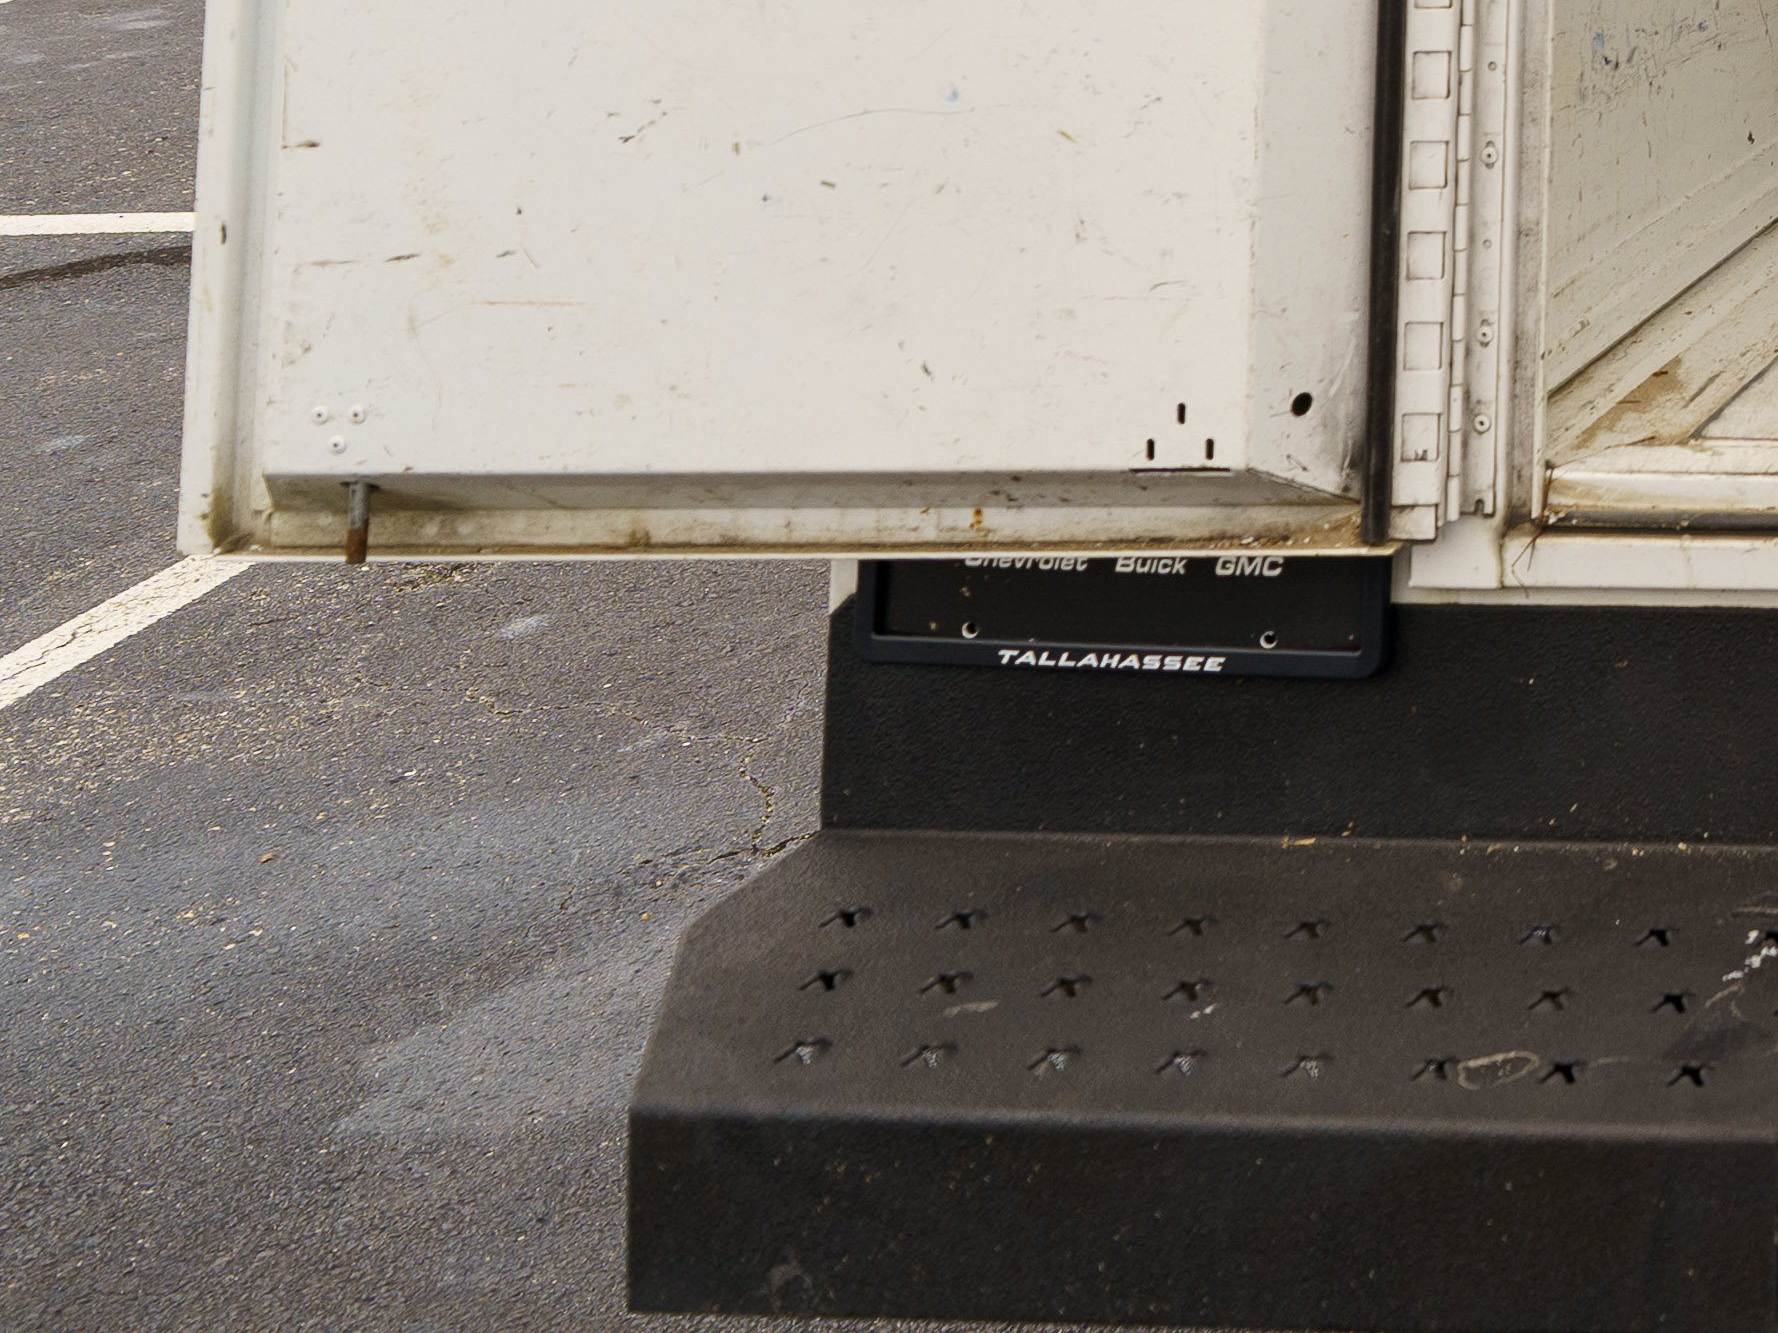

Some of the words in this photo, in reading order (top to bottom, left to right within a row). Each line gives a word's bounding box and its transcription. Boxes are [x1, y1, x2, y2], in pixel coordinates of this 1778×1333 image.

[1114, 556, 1188, 575] Buick
[1215, 555, 1284, 576] GMC
[998, 649, 1226, 671] TALLAHASSEE
